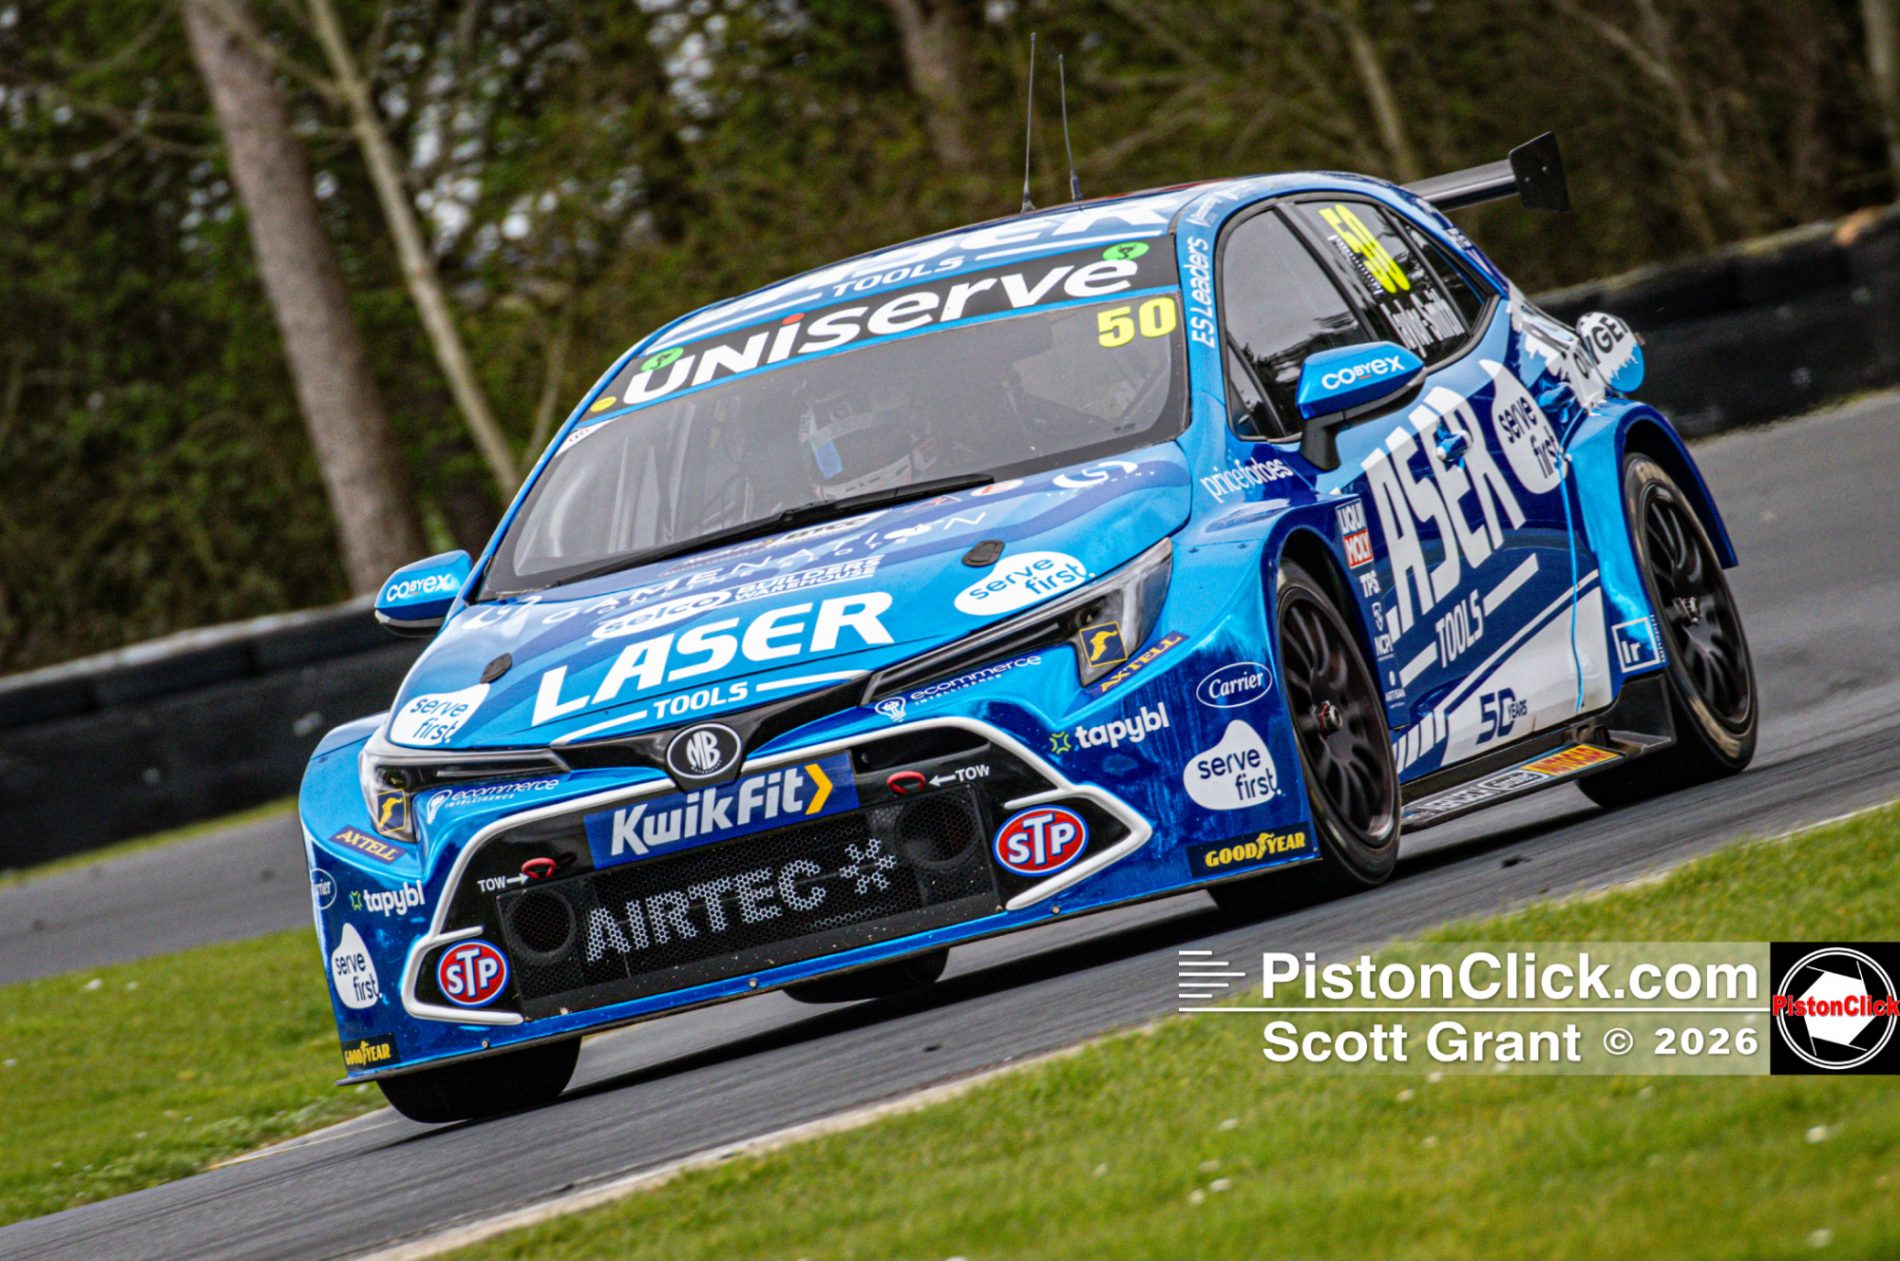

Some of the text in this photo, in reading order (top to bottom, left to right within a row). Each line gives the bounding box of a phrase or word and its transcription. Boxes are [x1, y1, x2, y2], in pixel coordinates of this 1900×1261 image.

[832, 255, 967, 298] TOOLS
[1097, 296, 1178, 348] 50
[1497, 396, 1538, 444] serve
[1361, 386, 1526, 646] ASER
[1346, 533, 1373, 565] MOLY
[735, 565, 876, 601] WAREHOUSE
[737, 556, 881, 593] BUILDERS
[969, 558, 1055, 601] serve
[1435, 588, 1485, 669] TOOLS
[532, 591, 895, 727] LASER
[910, 654, 1042, 701] ecommerce
[1101, 634, 1183, 693] AXTELL
[653, 681, 748, 719] TOOLS
[914, 674, 1003, 706] INTELLIGENCE
[1208, 670, 1264, 699] Carrier
[410, 697, 469, 717] serve
[1075, 702, 1170, 748] tapybl
[1507, 698, 1528, 721] YEARS
[955, 763, 990, 783] TOW
[1197, 748, 1261, 780] serve
[450, 778, 559, 801] ecommerce
[336, 829, 400, 861] AXTELL
[1007, 813, 1076, 866] STP
[1204, 832, 1306, 868] GOODYEAR
[363, 879, 426, 917] tapybl
[477, 875, 507, 893] TOW
[587, 859, 827, 963] AIRTEC
[335, 951, 366, 977] serve
[446, 947, 499, 998] STP
[344, 1040, 391, 1066] GOODYEAR
